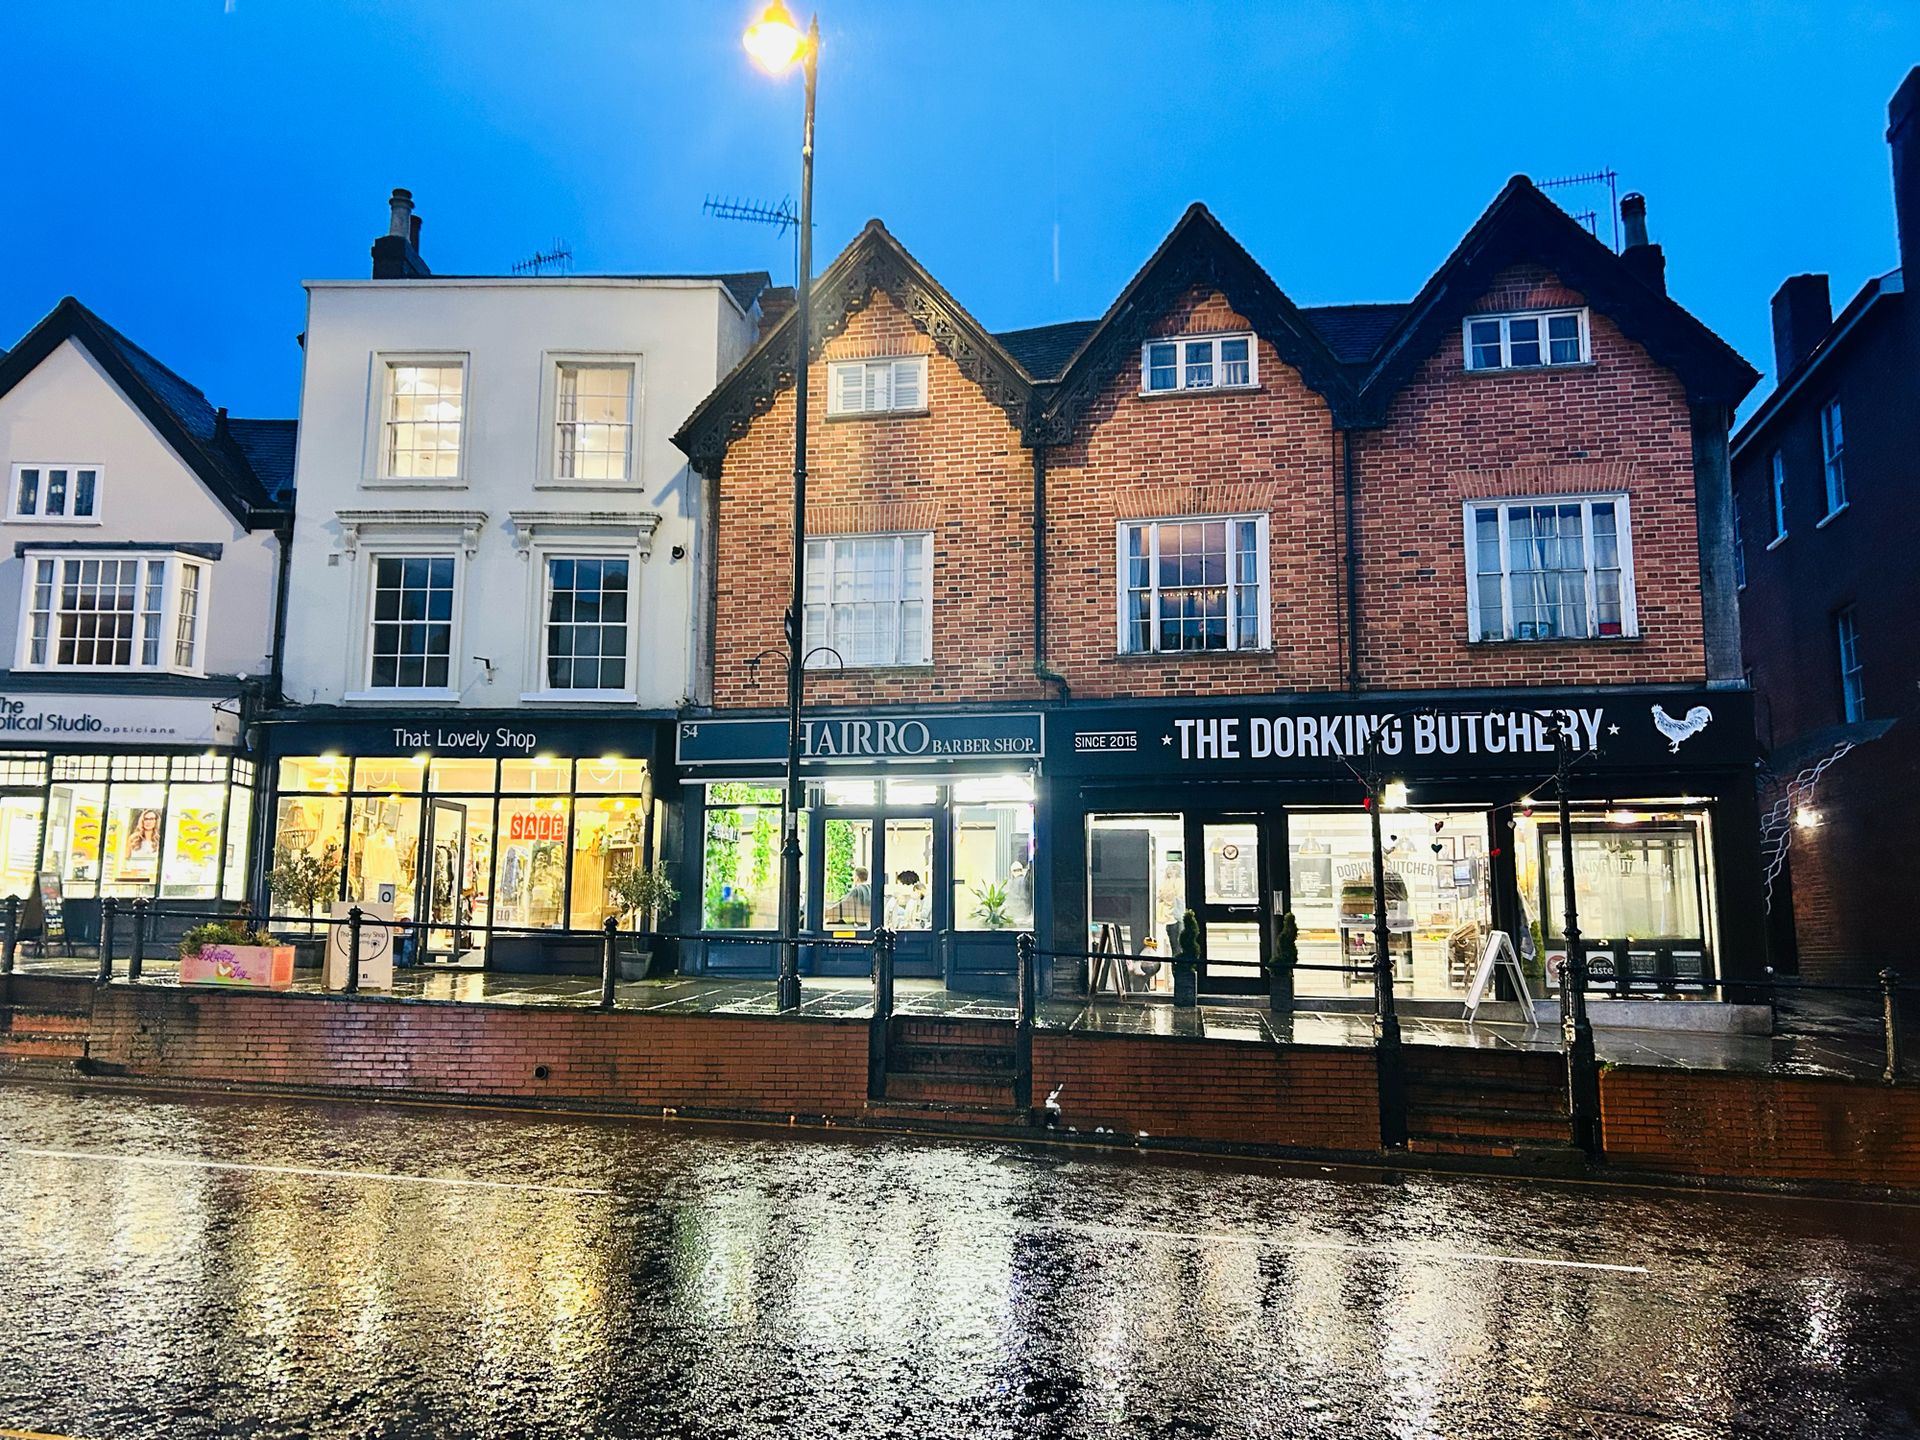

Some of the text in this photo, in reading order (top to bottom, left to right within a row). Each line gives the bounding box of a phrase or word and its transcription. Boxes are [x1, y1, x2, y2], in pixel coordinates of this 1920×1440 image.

[46, 713, 102, 732] Studio
[103, 726, 176, 735] opticians
[682, 724, 699, 739] 54
[1174, 708, 1604, 759] THE DORKING BUTCHERY
[393, 727, 536, 753] That Lovely Shop
[932, 737, 1036, 753] BARBER SHOP.
[1075, 735, 1137, 748] SINCE 2015
[511, 819, 563, 837] SALE
[1588, 966, 1614, 975] taste
